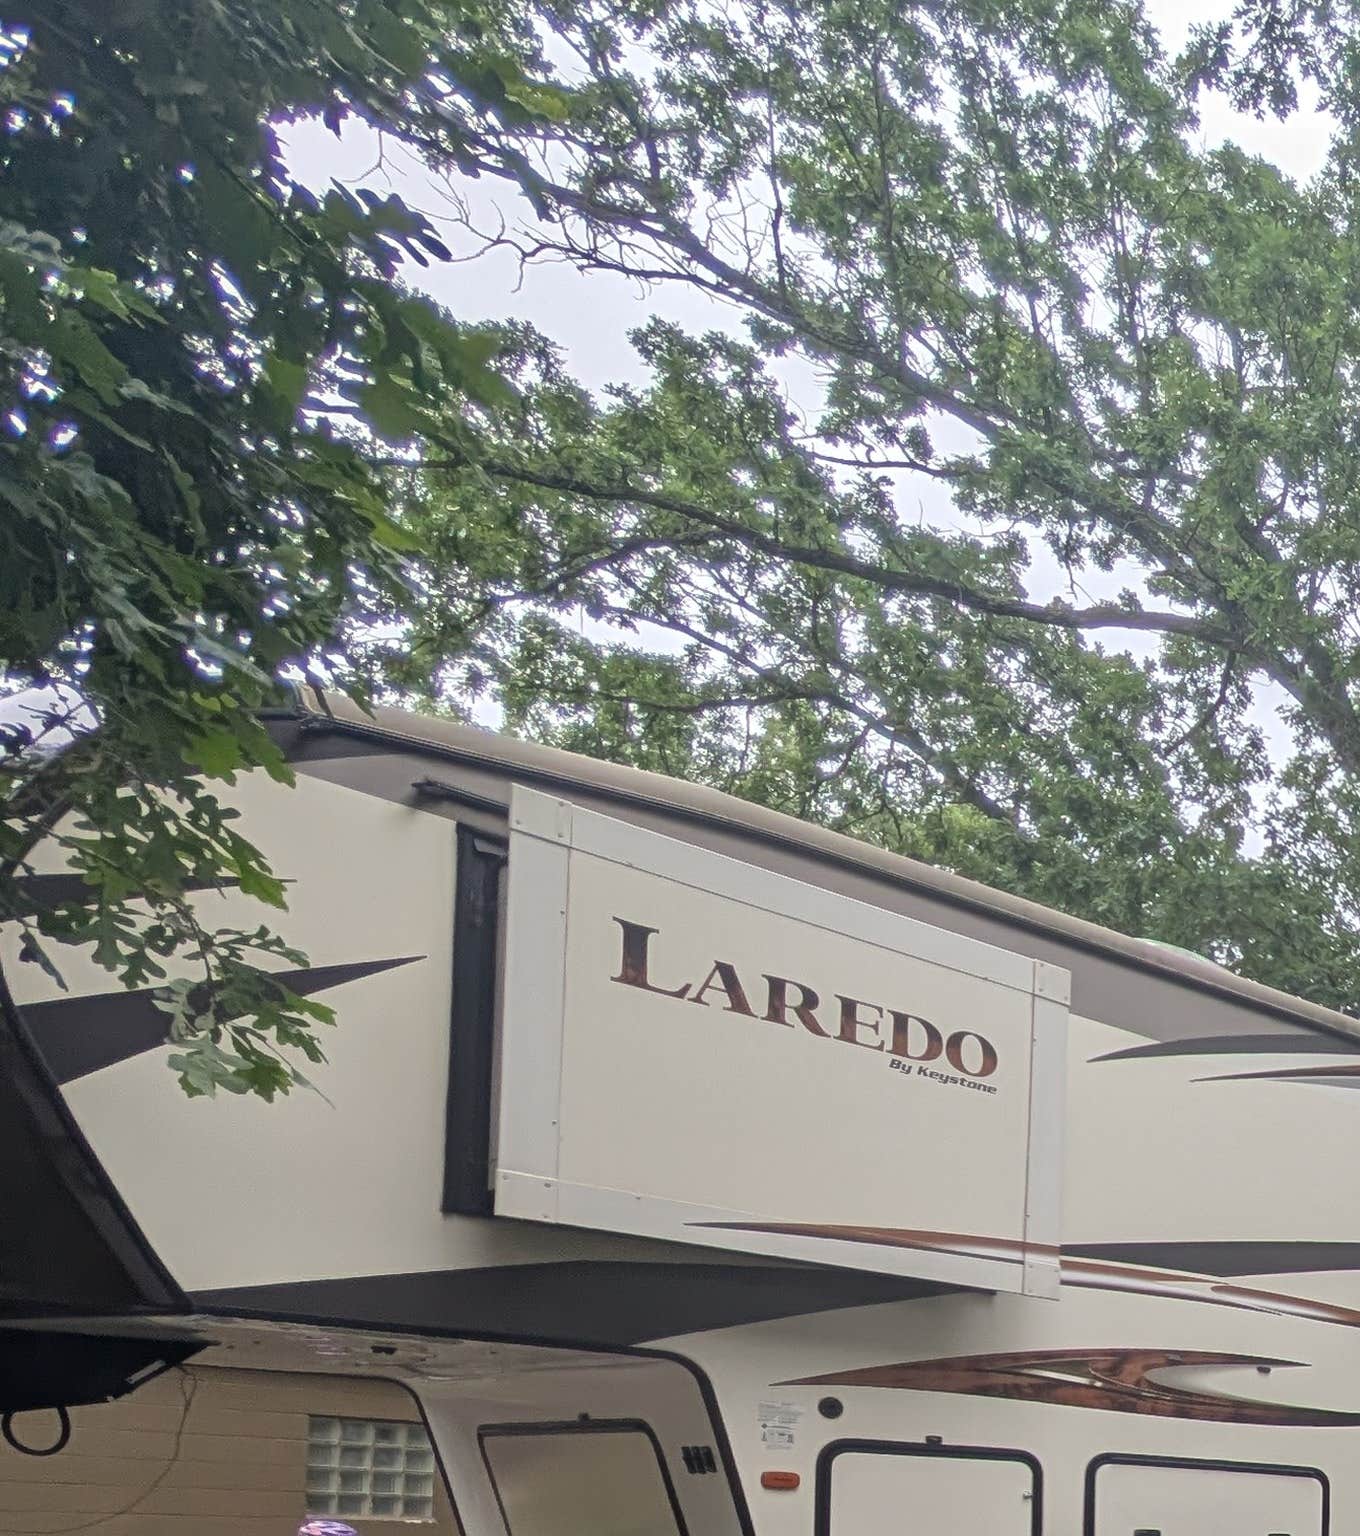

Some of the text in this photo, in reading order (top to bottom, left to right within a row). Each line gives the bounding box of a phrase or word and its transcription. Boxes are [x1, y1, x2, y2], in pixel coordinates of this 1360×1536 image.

[610, 916, 998, 1077] LAREDO
[889, 1058, 998, 1095] By Keystone
